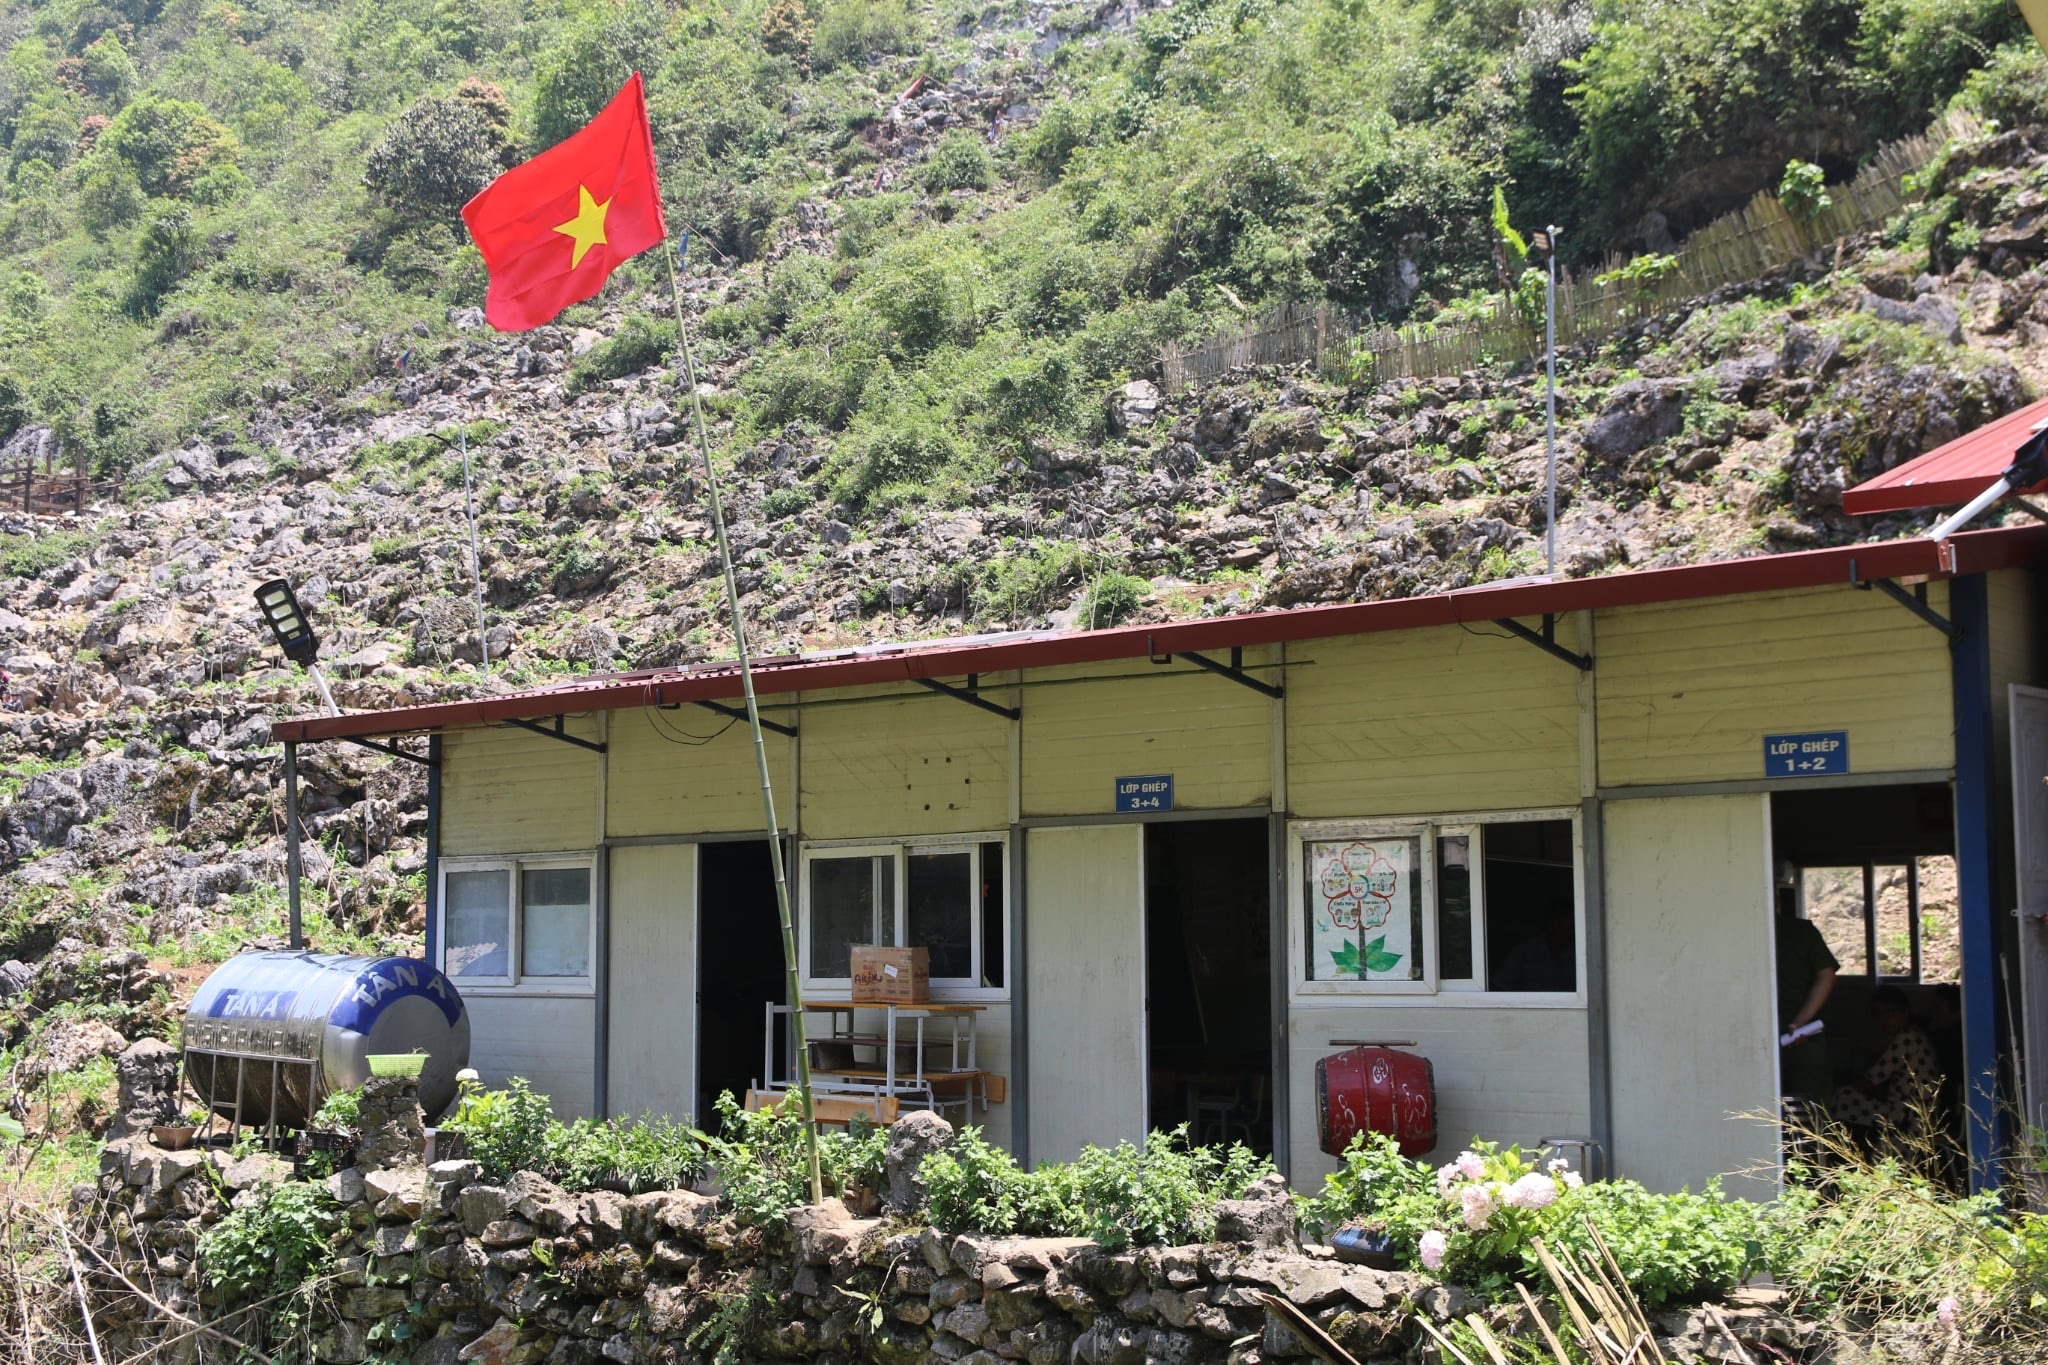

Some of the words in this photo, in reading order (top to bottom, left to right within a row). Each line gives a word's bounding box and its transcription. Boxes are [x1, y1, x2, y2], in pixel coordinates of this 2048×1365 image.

[1771, 740, 1798, 755] LỚP
[1801, 738, 1840, 753] GHÉP
[1784, 757, 1826, 772] 1+2
[1120, 782, 1140, 794] LỚP
[1141, 780, 1168, 793] GHÉP
[1131, 797, 1160, 808] 3+4
